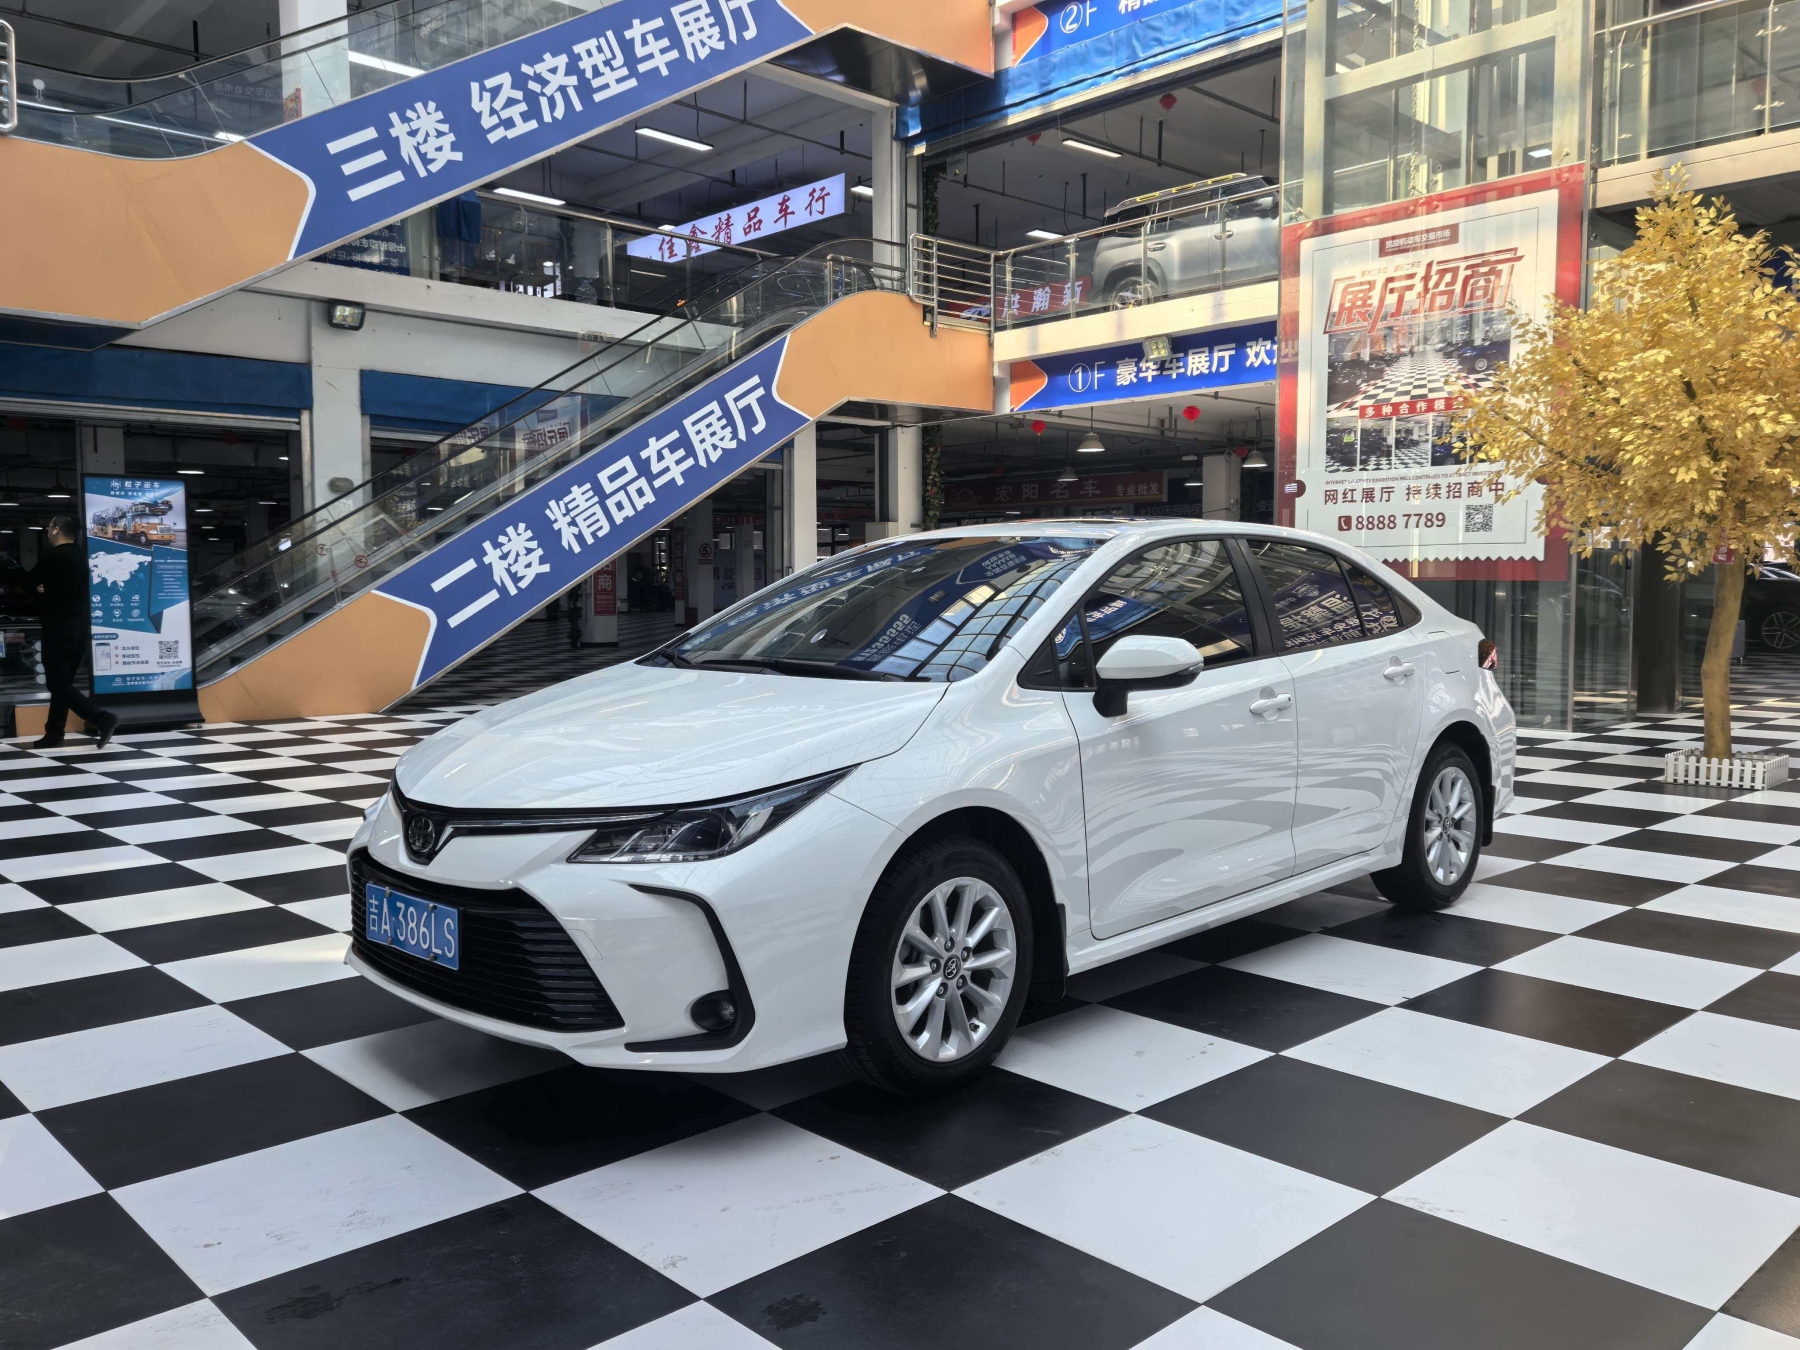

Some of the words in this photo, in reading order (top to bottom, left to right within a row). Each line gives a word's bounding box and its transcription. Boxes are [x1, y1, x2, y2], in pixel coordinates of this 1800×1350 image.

[326, 100, 463, 202] 三楼
[470, 0, 758, 146] 经济型车展厅
[658, 186, 830, 262] 佳鑫精品车行
[1333, 254, 1525, 335] 展厅招商
[1116, 343, 1236, 387] 豪华车展厅
[430, 522, 551, 629] 二楼
[544, 374, 768, 554] 精品车展厅
[994, 478, 1102, 502] 宏阳名车
[1115, 481, 1160, 497] 专业批发
[1324, 486, 1395, 505] 网红展厅
[1405, 479, 1505, 502] 持续招商中
[1355, 514, 1397, 531] 8888
[1402, 512, 1446, 529] 7789
